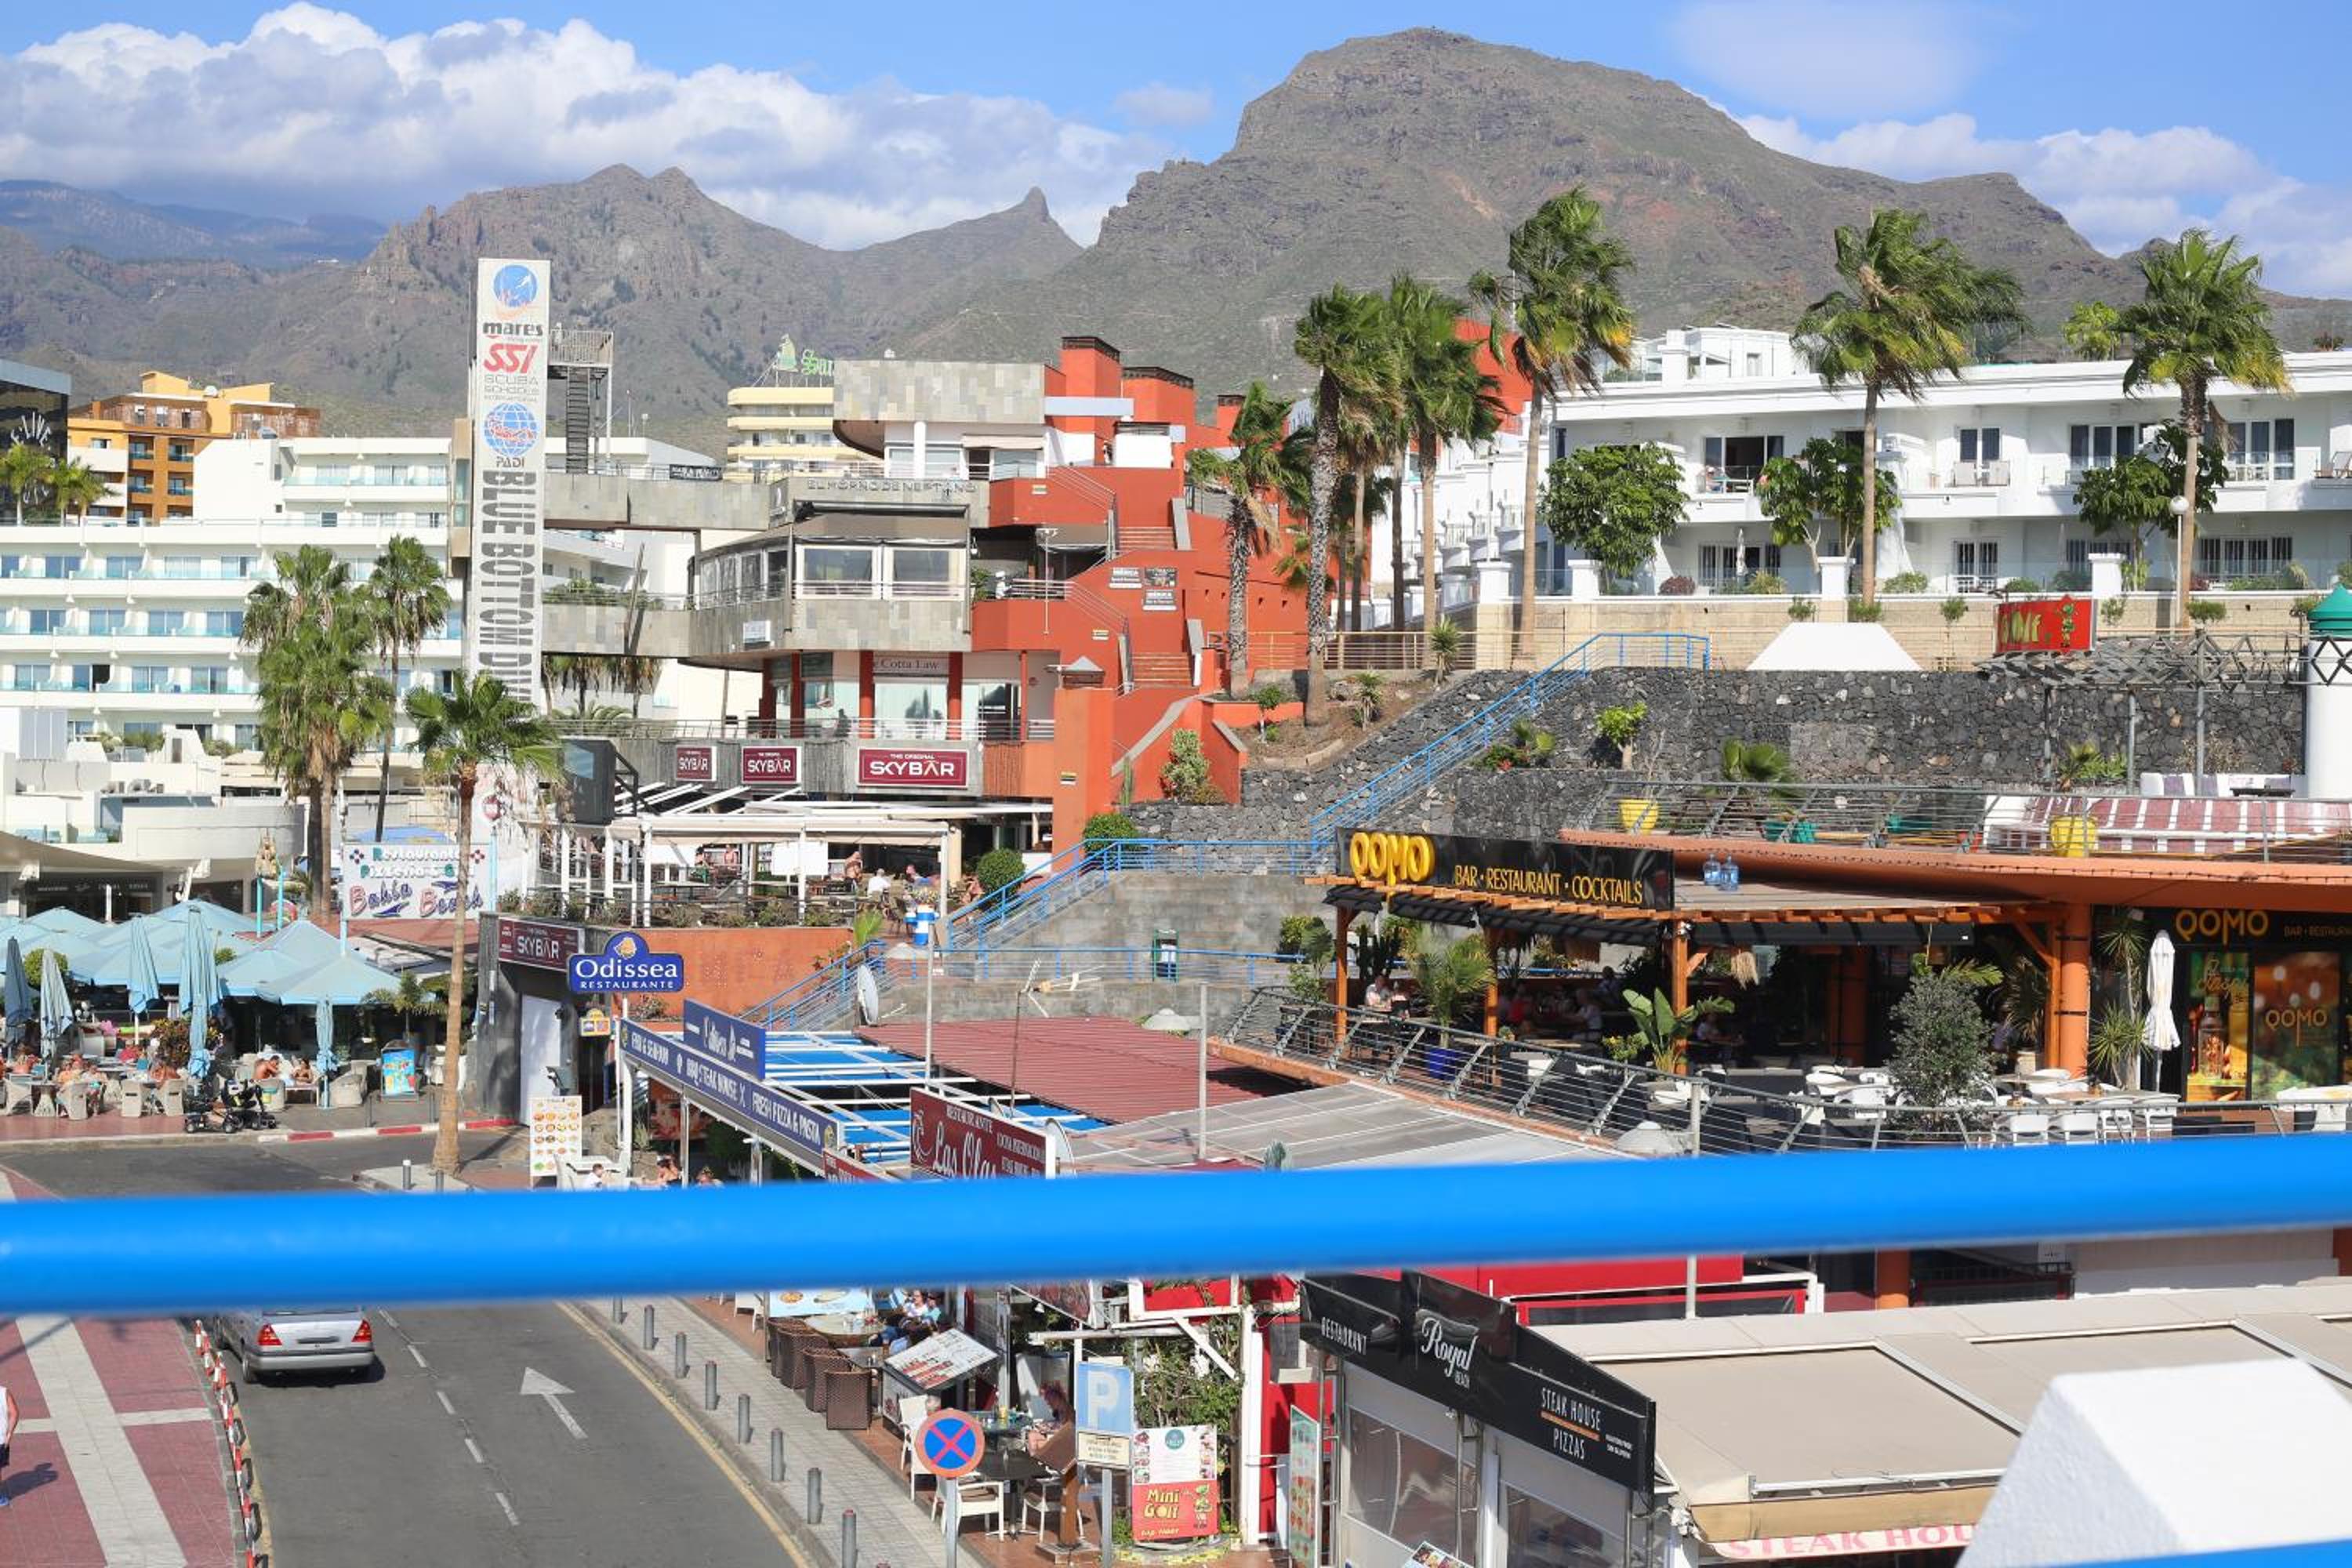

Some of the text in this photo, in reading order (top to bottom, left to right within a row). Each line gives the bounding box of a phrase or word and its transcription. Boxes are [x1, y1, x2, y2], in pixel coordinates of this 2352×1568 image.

[483, 322, 543, 337] mares
[484, 343, 539, 374] SSI
[496, 457, 524, 468] PADI
[482, 470, 536, 535] BLUE
[479, 543, 535, 645] BOTTOM
[1454, 865, 1643, 905] BAR RESTAURANT COCKTAILS
[2176, 909, 2270, 946] QOMO
[575, 958, 678, 978] Odissea
[580, 981, 674, 989] RESTAURANTE
[2265, 1008, 2328, 1044] QOMO
[1320, 1316, 1367, 1356] RESTAURANT
[1421, 1318, 1479, 1377] Royal
[1087, 1370, 1120, 1428] P
[1540, 1387, 1601, 1429] STEAK HOUSE
[1552, 1427, 1585, 1460] PIZZAS
[1729, 1531, 1869, 1557] STEAK
